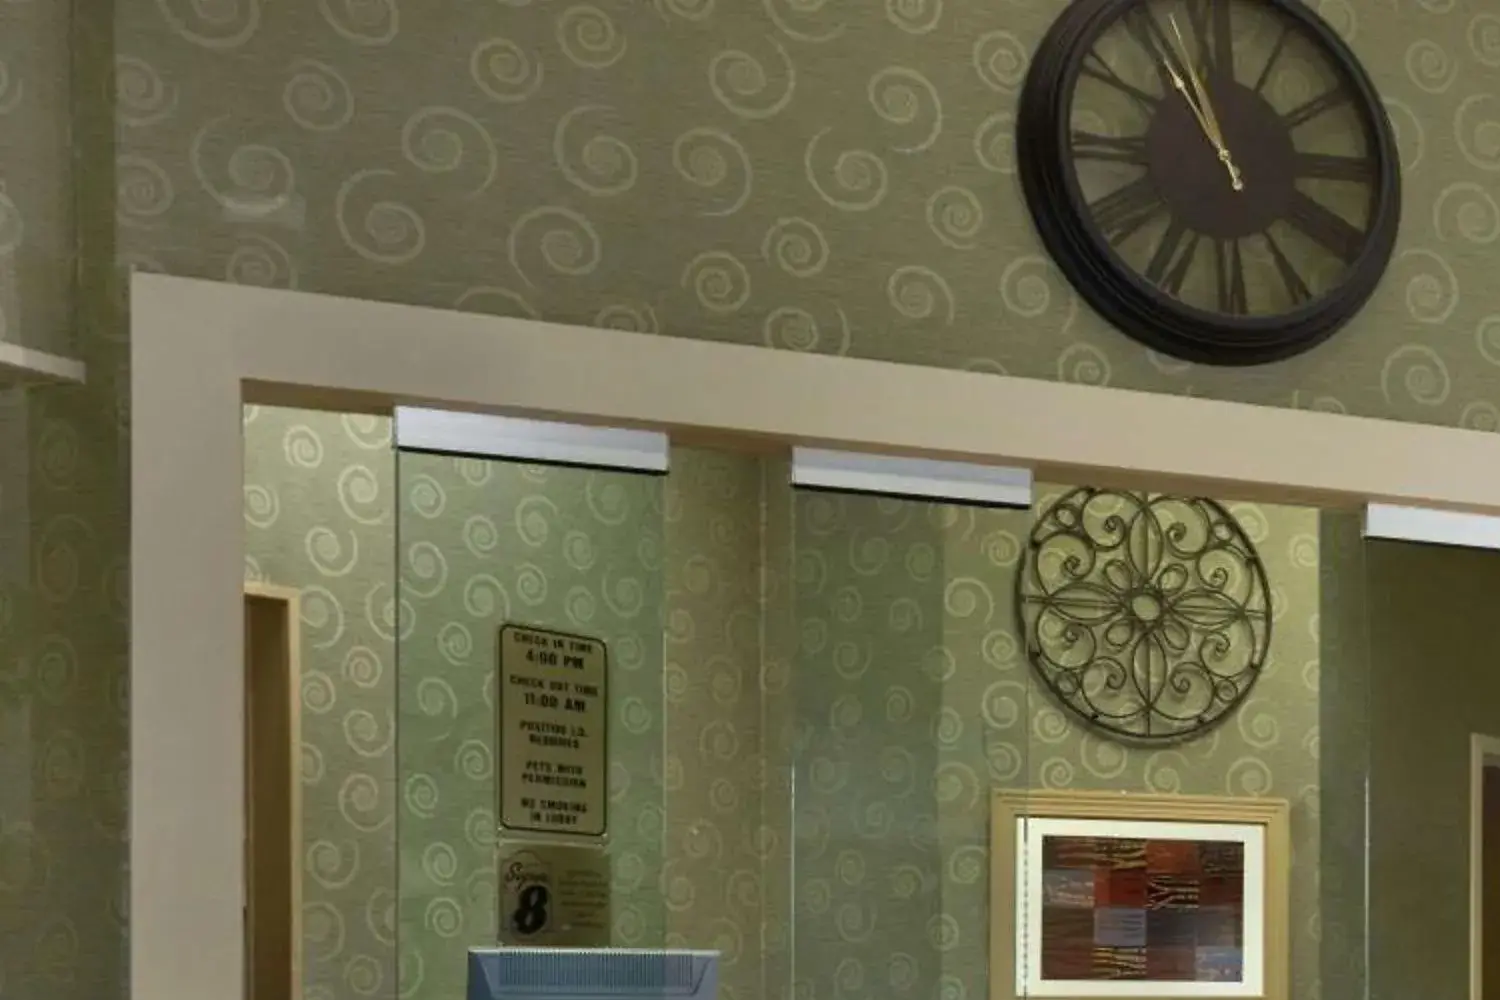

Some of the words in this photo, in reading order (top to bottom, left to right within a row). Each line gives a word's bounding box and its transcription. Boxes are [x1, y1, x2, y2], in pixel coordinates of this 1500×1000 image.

[553, 639, 564, 650] IN
[563, 655, 585, 671] PM
[510, 674, 545, 690] CHECK
[524, 692, 559, 710] 11:00
[564, 697, 586, 713] AM
[513, 885, 548, 936] 8
